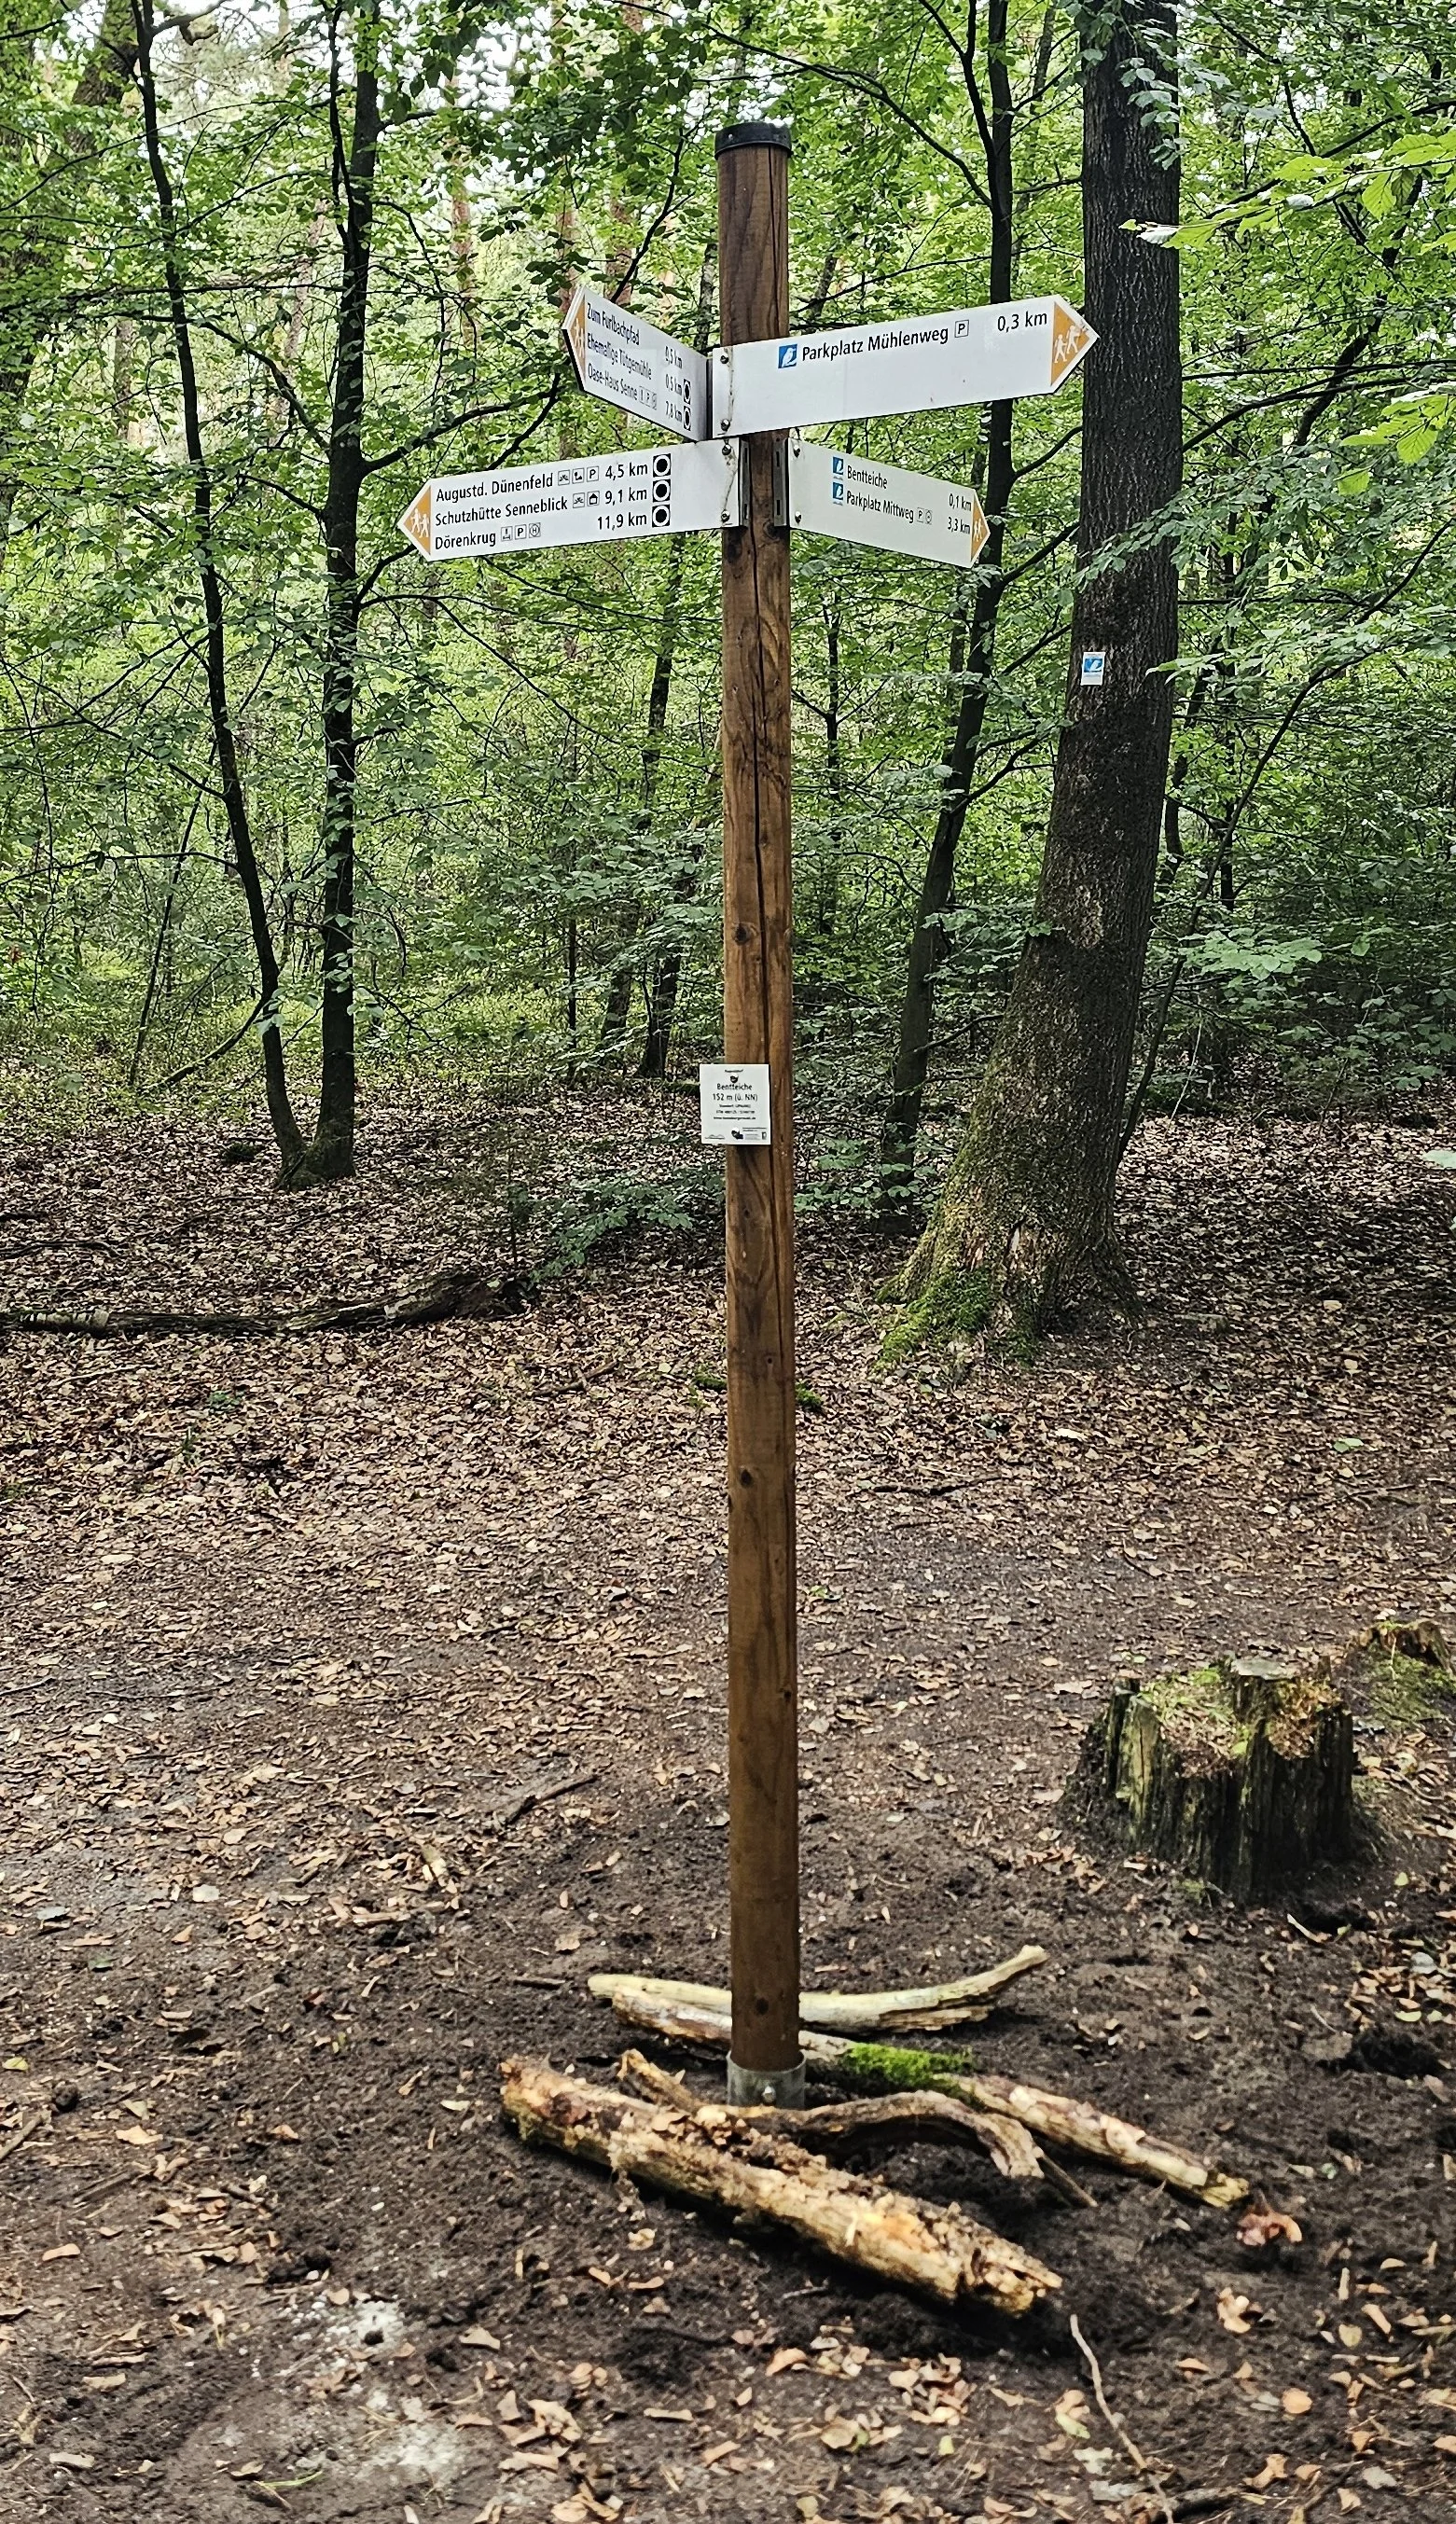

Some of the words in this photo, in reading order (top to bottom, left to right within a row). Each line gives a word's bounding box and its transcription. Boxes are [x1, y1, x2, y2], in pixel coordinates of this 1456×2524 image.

[802, 340, 864, 361] Parkplatz
[867, 327, 949, 352] Mühlenweg
[957, 323, 965, 335] P
[997, 313, 1019, 333] 0,3
[1025, 311, 1047, 327] km
[674, 351, 683, 369] km
[674, 377, 683, 395] km
[674, 404, 683, 423] km
[436, 482, 488, 504] Augustd.
[492, 472, 553, 495] Dünenfeld
[605, 465, 624, 480] 4,5
[629, 462, 648, 477] km
[847, 465, 888, 489] Bentteiche
[949, 492, 960, 509] 0,1
[961, 495, 972, 512] km
[435, 507, 502, 527] Schutzhütte
[505, 496, 568, 518] Senneblick
[604, 489, 623, 506] 9,1
[629, 487, 647, 502] km
[846, 490, 881, 512] Parkplatz
[882, 499, 914, 523] Mittweg
[948, 516, 958, 533] 3,3
[960, 519, 971, 534] km
[435, 531, 496, 550] Dörenkrug
[597, 514, 624, 531] 11,9
[628, 512, 647, 527] km
[713, 1092, 725, 1101] 152
